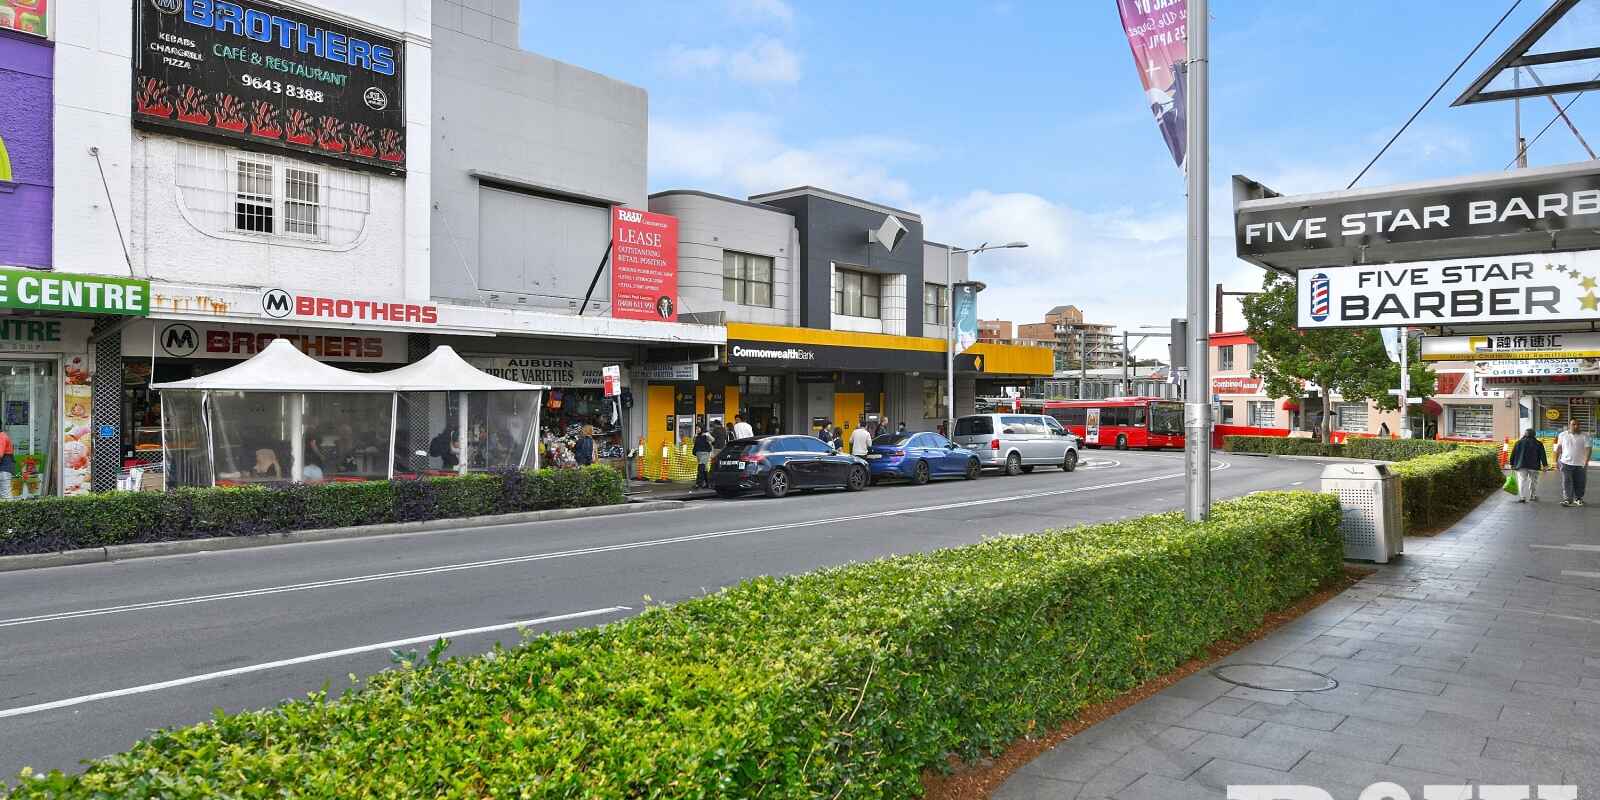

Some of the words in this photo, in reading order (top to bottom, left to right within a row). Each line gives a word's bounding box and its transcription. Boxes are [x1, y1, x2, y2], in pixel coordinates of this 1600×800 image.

[150, 42, 203, 61] CHARGRILL
[159, 31, 196, 48] KEBABS
[184, 0, 395, 76] BROTHERS
[163, 56, 192, 69] PIZZA
[213, 43, 249, 62] CAFÉ
[250, 52, 262, 65] &
[265, 55, 347, 86] RESTAURANT
[241, 73, 282, 94] 9643
[286, 83, 324, 103] 8388
[618, 227, 662, 247] LEASE
[1245, 217, 1327, 245] FIVE
[1341, 204, 1451, 236] STAR
[1358, 267, 1429, 288] FIVE
[1441, 261, 1534, 283] STAR
[17, 276, 142, 311] CENTRE
[1340, 285, 1560, 321] BARBER
[295, 295, 438, 324] BROTHERS
[508, 359, 574, 368] AUBURN
[521, 368, 575, 382] VARIETIES
